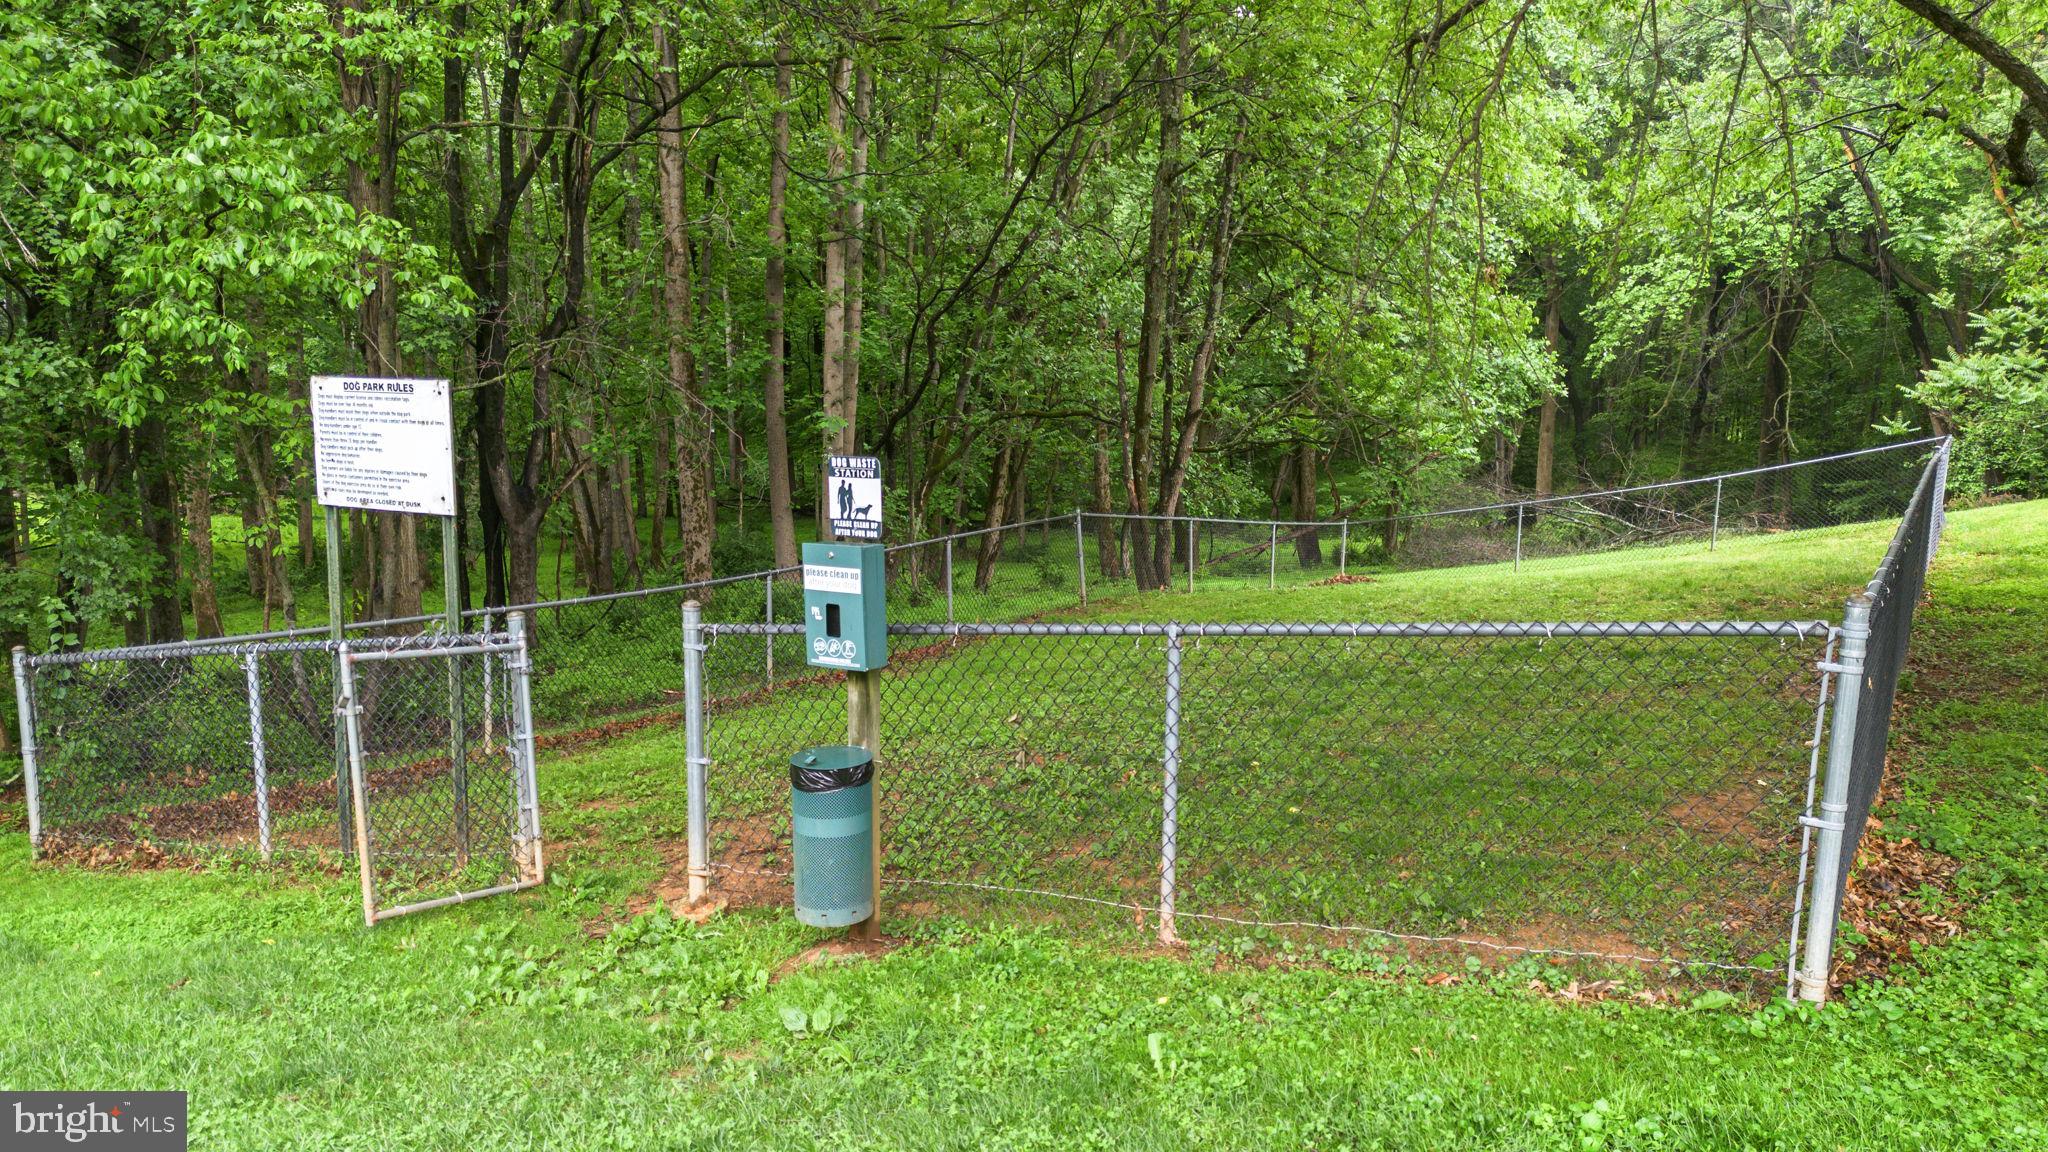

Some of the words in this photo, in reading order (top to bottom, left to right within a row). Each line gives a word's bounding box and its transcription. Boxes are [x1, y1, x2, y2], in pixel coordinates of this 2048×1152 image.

[343, 381, 361, 391] DOG
[362, 382, 385, 392] PARK
[387, 382, 414, 393] RULES
[831, 457, 847, 467] DOG
[849, 458, 876, 468] WASTE
[834, 468, 874, 478] STATION
[375, 499, 396, 507] CLOSED
[853, 521, 870, 529] CLEAN
[870, 522, 878, 530] UP
[835, 528, 850, 536] AFTER
[851, 529, 866, 537] YOUR
[866, 530, 878, 538] DOG
[805, 568, 829, 578] please
[829, 570, 849, 579] clean
[850, 572, 859, 581] up
